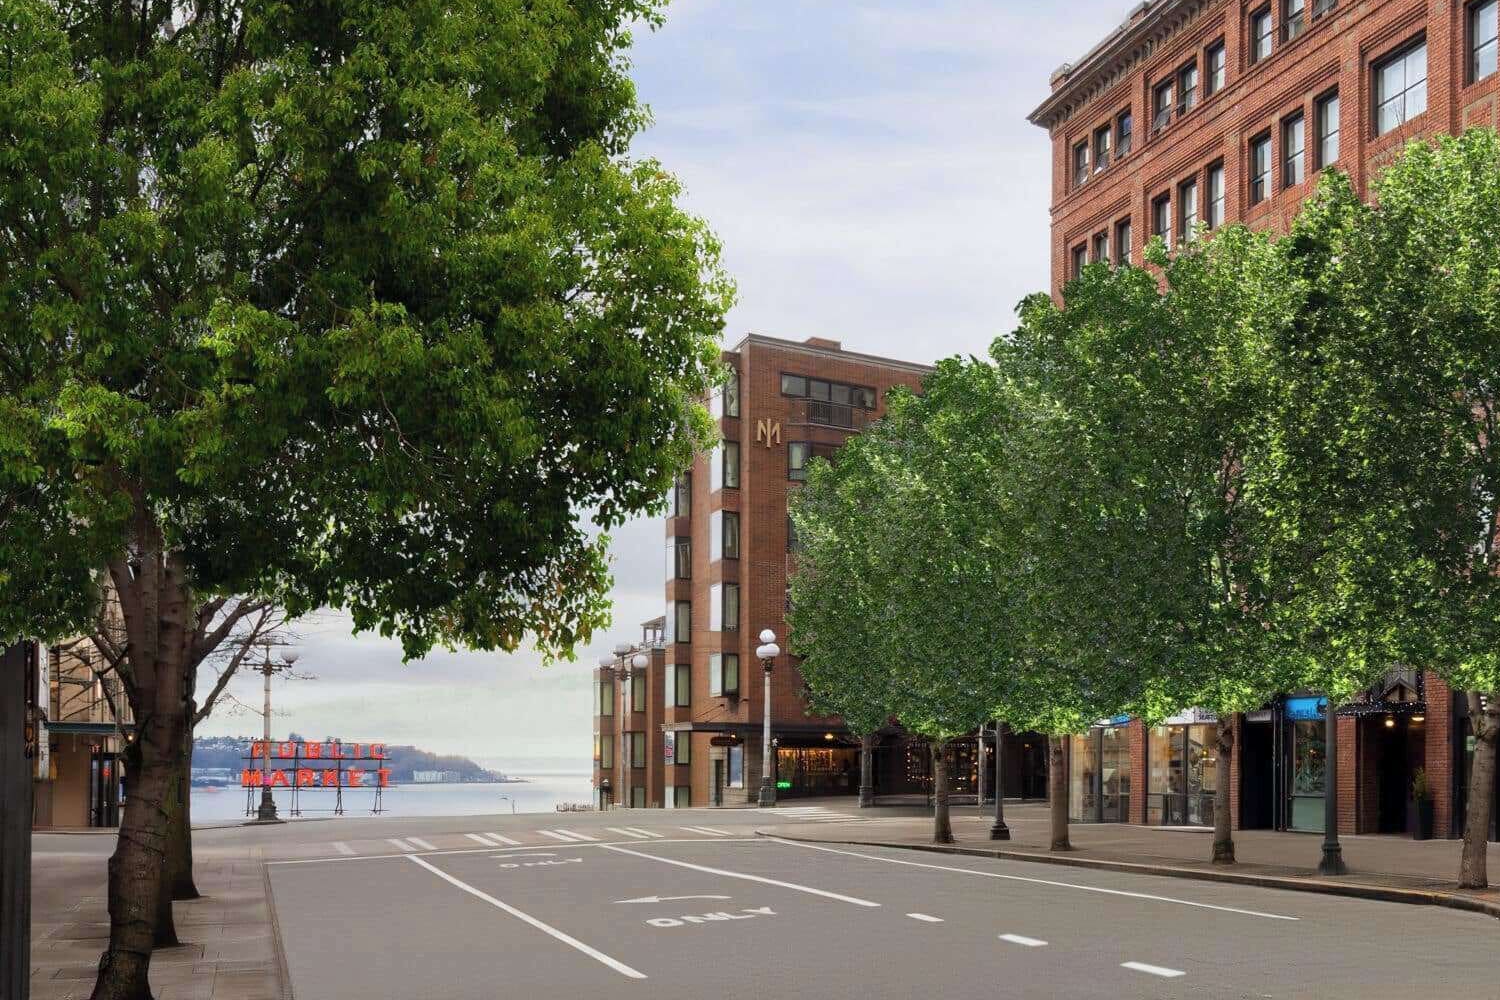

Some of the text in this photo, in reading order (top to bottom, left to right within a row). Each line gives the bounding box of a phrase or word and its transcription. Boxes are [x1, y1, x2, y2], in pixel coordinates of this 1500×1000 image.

[252, 741, 385, 760] PUBLIC
[242, 768, 392, 787] MARKET
[646, 906, 777, 928] ONLY
